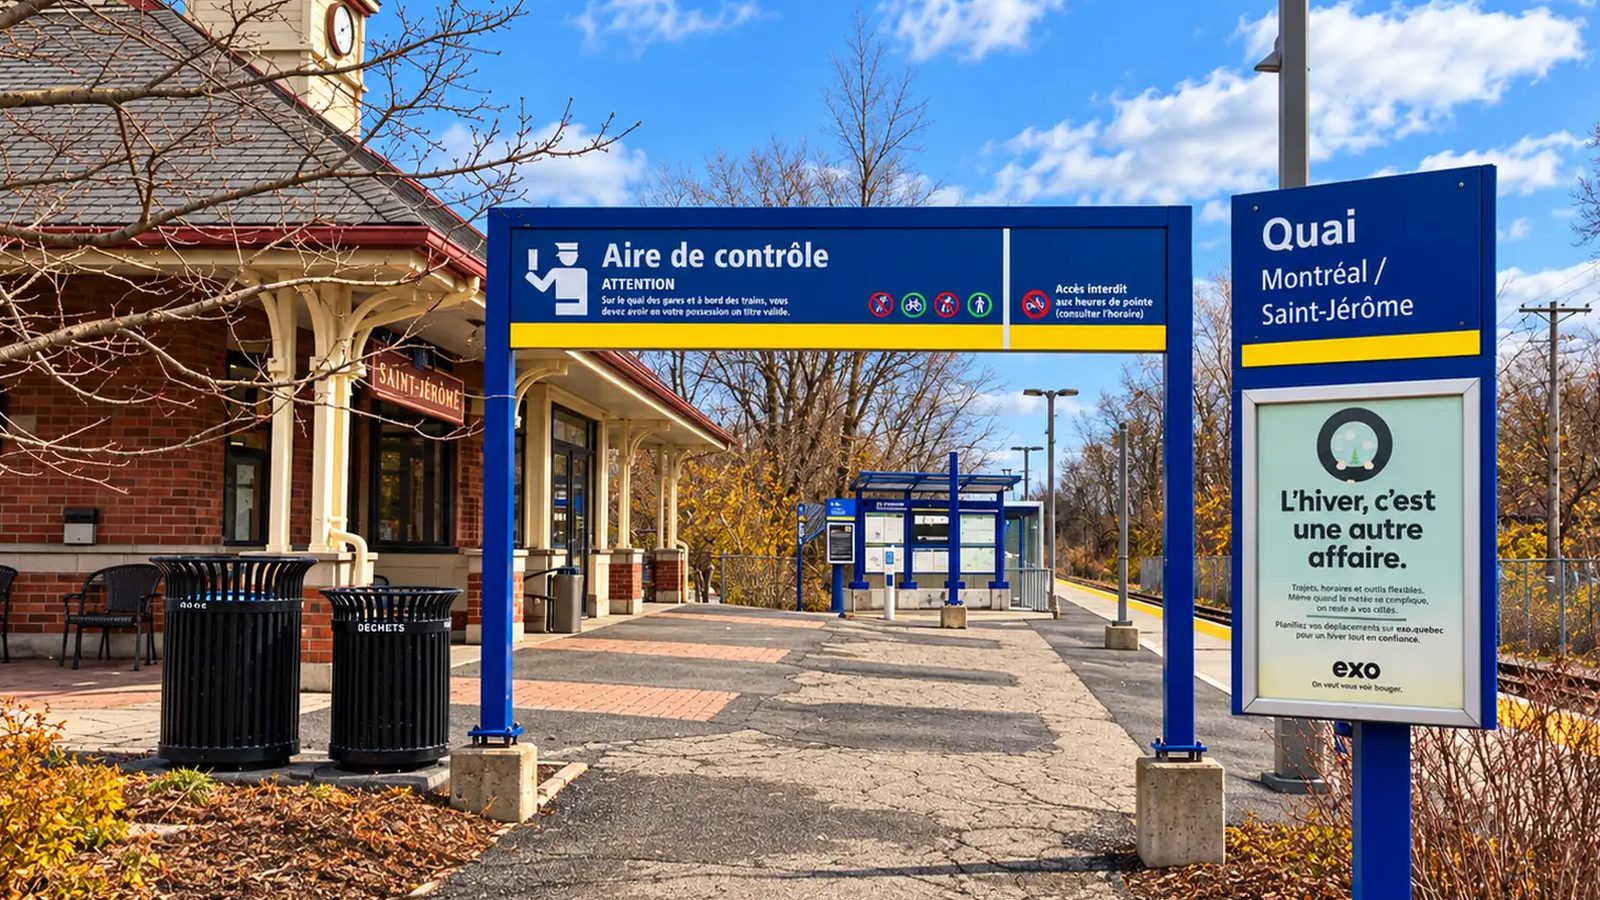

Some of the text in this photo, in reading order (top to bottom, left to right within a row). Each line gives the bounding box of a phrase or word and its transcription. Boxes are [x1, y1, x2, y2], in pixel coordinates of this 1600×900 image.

[1263, 208, 1356, 252] Quai
[602, 241, 828, 268] Aire de contrôle
[1262, 256, 1387, 291] Montréal /
[602, 278, 675, 290] ATTENTION
[1056, 283, 1127, 294] Accès interdit
[602, 296, 616, 304] Sur
[686, 296, 696, 304] et
[704, 296, 724, 304] bord
[725, 296, 740, 304] des
[741, 296, 768, 306] trains,
[1075, 297, 1106, 306] heures
[1108, 297, 1120, 306] de
[1122, 297, 1153, 308] pointe
[662, 308, 684, 316] votre
[1056, 309, 1100, 318] (consulter
[1262, 296, 1414, 326] Saint-Jérôme
[1294, 519, 1423, 540] une autre
[1308, 544, 1406, 569] affaire.
[1296, 632, 1314, 640] pour
[1378, 634, 1420, 644] confiance.
[1332, 660, 1380, 680] exo
